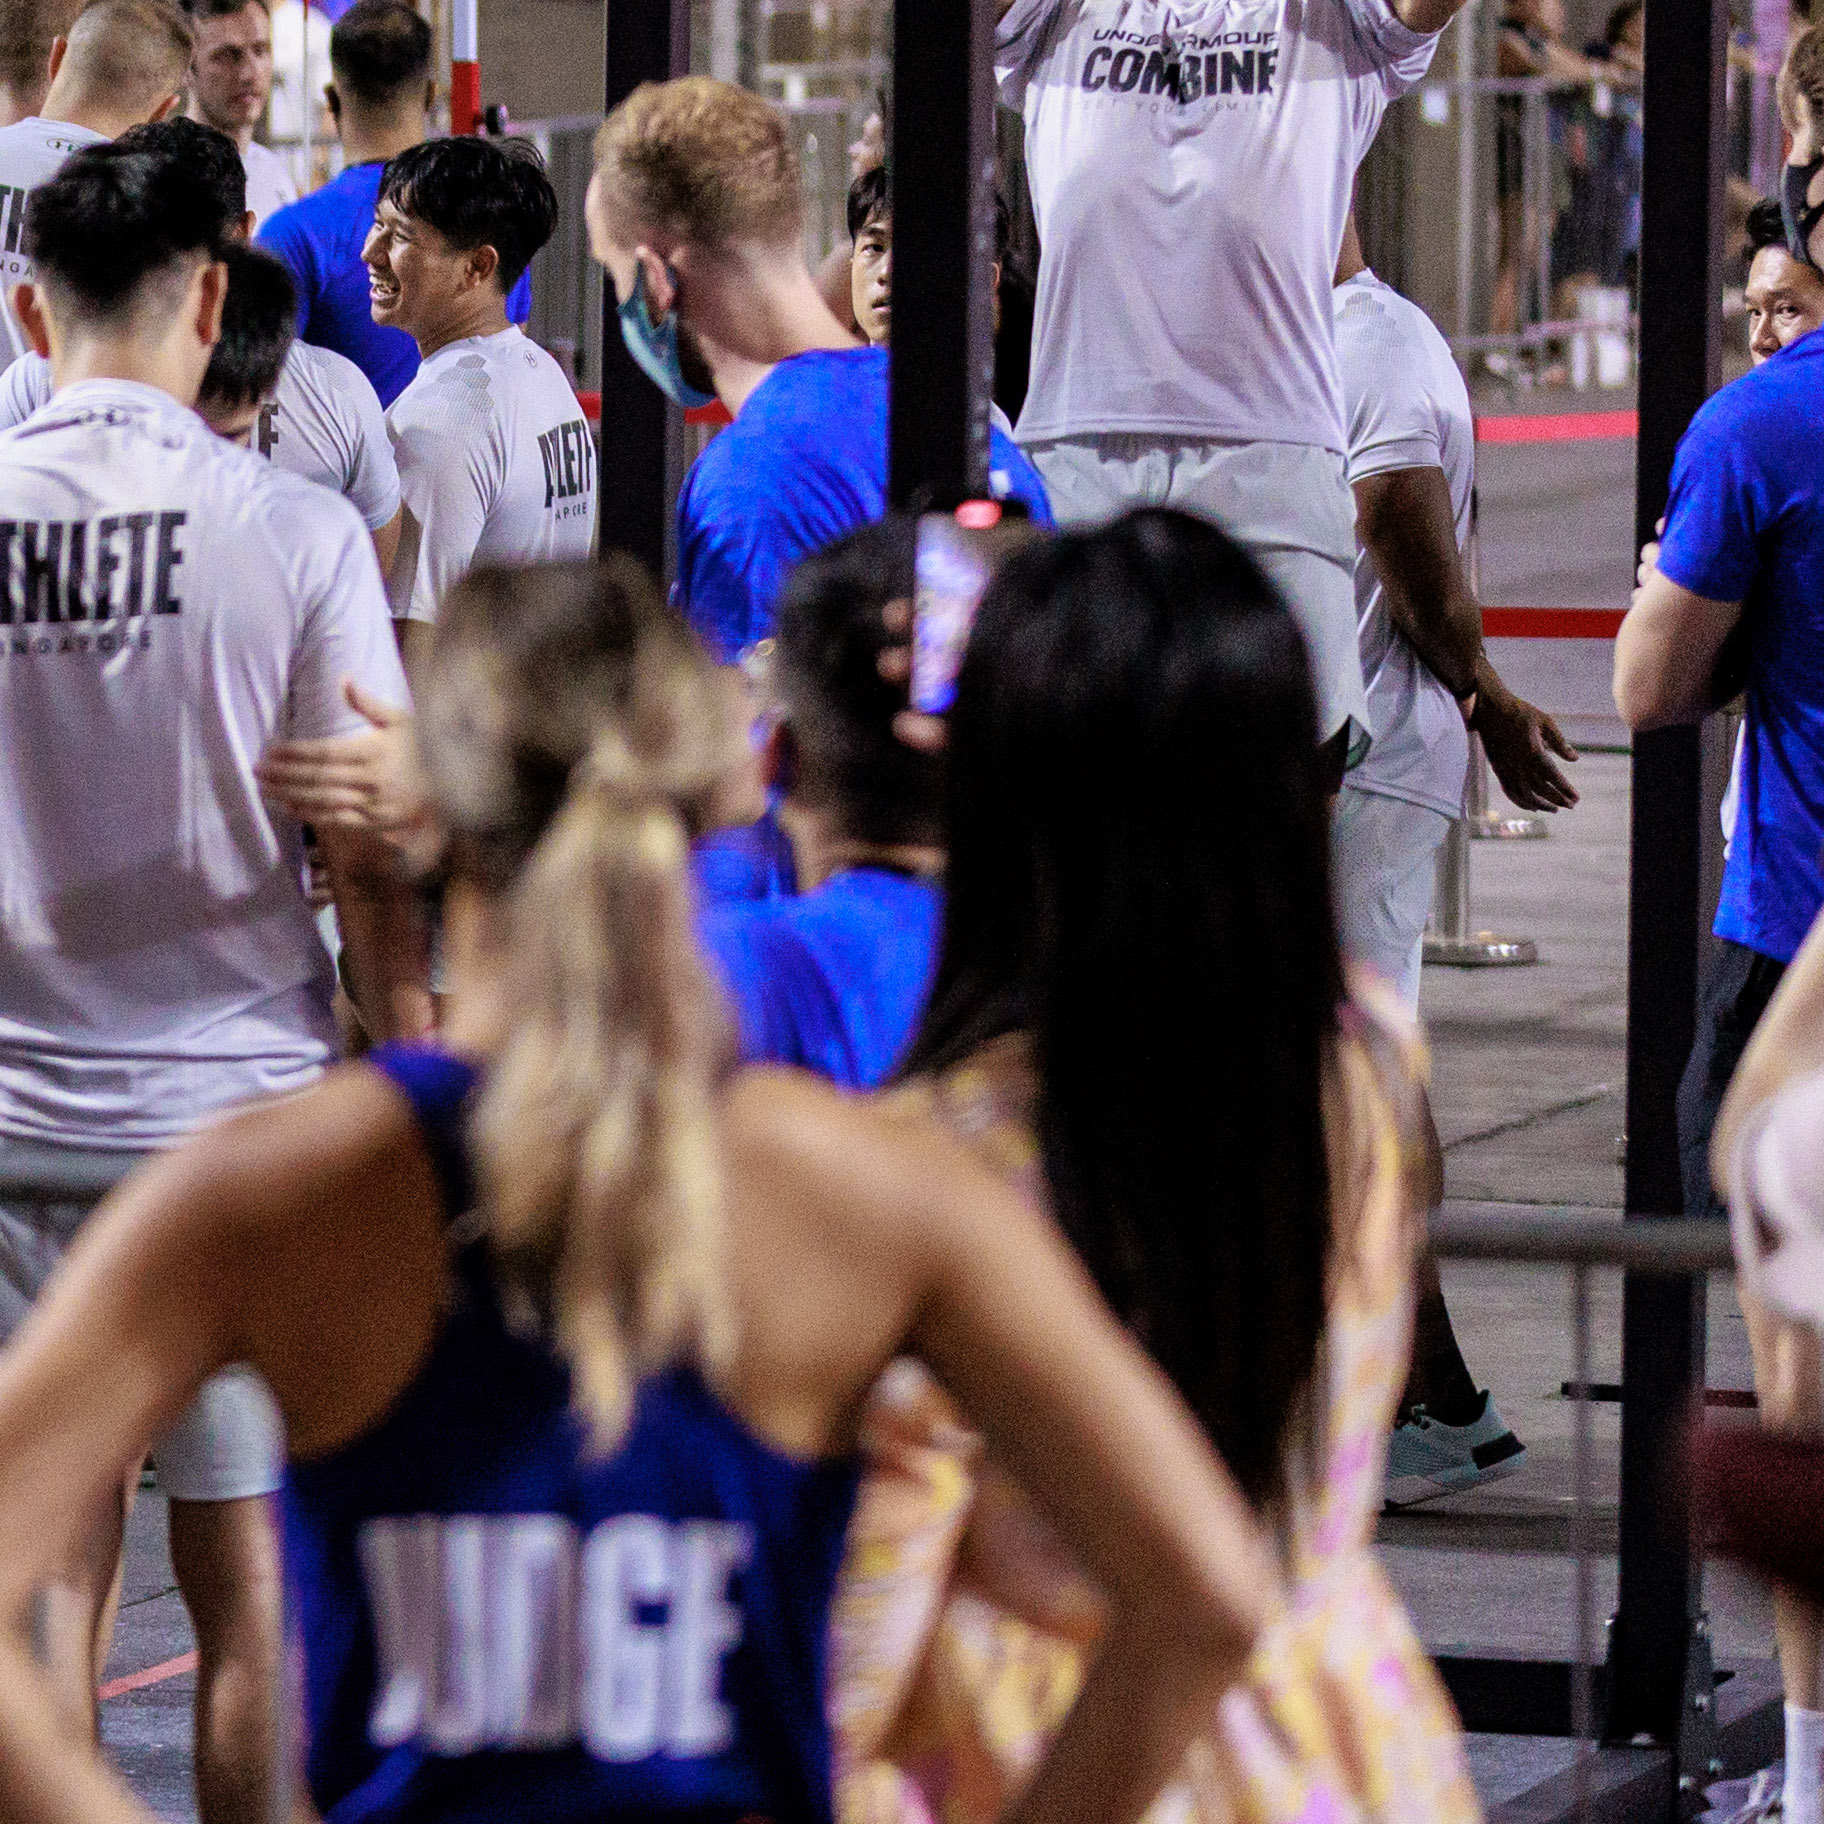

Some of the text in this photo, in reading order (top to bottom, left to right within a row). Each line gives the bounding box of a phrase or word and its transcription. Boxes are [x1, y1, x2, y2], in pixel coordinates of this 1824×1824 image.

[1092, 28, 1160, 47] UNDE
[1081, 46, 1279, 106] COMBINE
[359, 1512, 754, 1762] JUDGE
